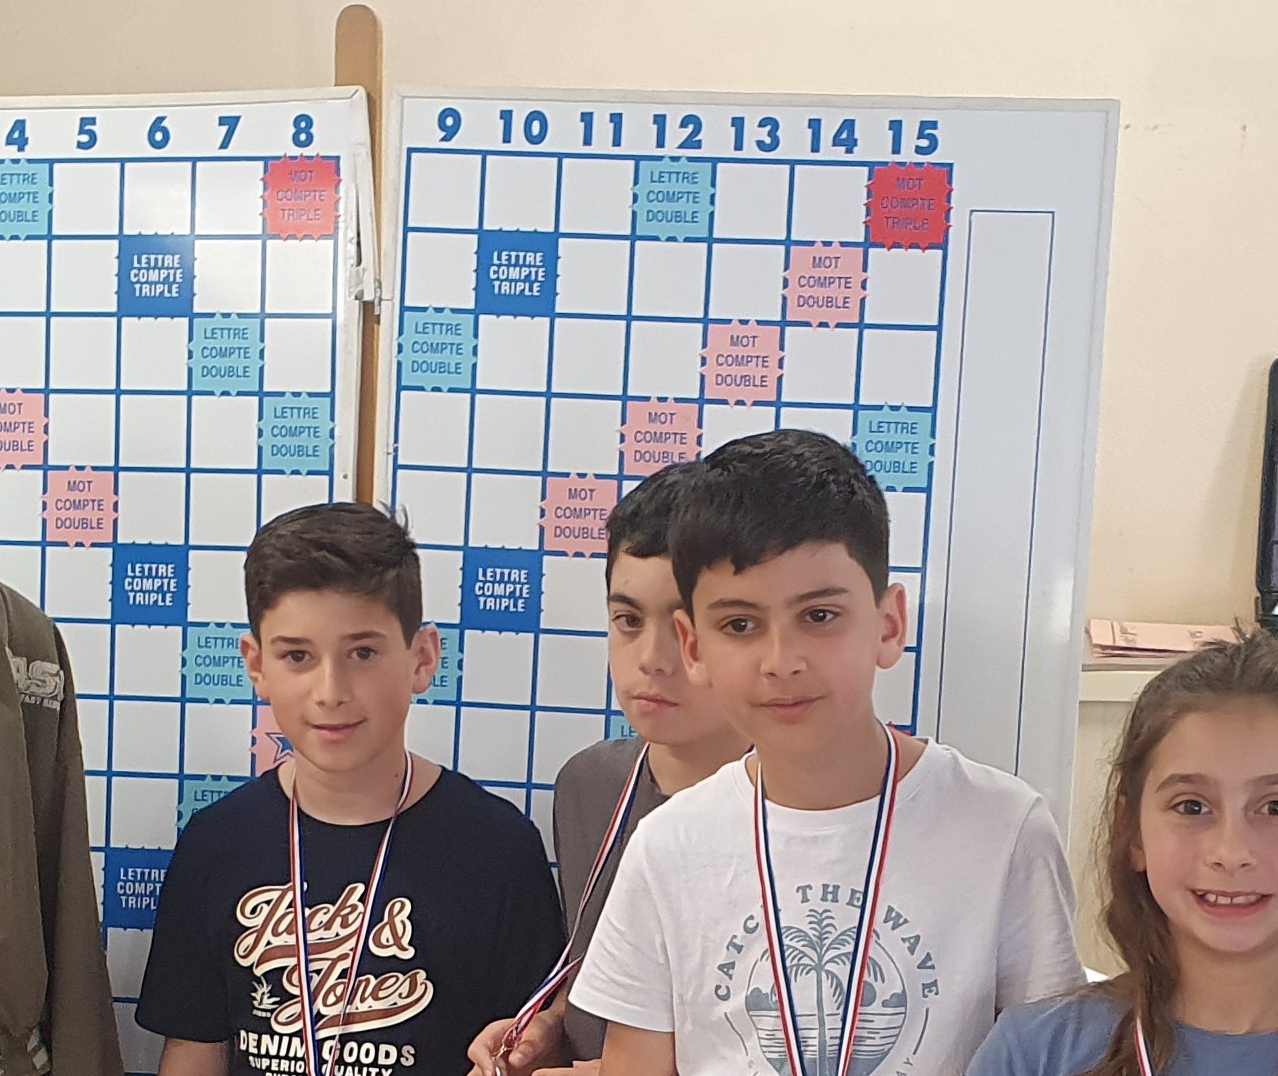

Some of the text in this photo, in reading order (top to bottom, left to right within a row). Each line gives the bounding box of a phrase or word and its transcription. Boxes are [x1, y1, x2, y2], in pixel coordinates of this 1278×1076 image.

[5, 119, 28, 153] 4
[76, 117, 98, 149] 5
[147, 117, 170, 150] 6
[218, 117, 242, 149] 7
[292, 114, 314, 146] 8
[438, 107, 938, 154] 9 10 11 12 13 14 15
[289, 170, 314, 183] MOT
[649, 171, 698, 185] LETTRE
[896, 177, 924, 190] MOT
[276, 189, 325, 202] COMPTE
[647, 190, 700, 204] COMPTE
[881, 196, 936, 211] COMPTE
[280, 208, 321, 222] TRIPLE
[646, 209, 699, 224] DOUBLE
[884, 216, 929, 231] TRIPLE
[133, 254, 181, 268] LETTRE
[493, 251, 544, 266] LETTRE
[812, 256, 841, 270] MOT
[130, 268, 183, 282] COMPTE
[490, 265, 545, 281] COMPTE
[133, 282, 180, 297] TRIPLE
[493, 280, 541, 296] TRIPLE
[798, 274, 852, 290] COMPTE
[797, 294, 850, 309] DOUBLE
[203, 326, 249, 340] LETTRE
[414, 321, 461, 336] LETTRE
[411, 341, 463, 356] COMPTE
[729, 334, 758, 349] MOT
[201, 345, 250, 360] COMPTE
[411, 360, 462, 375] DOUBLE
[716, 354, 769, 369] COMPTE
[201, 364, 250, 379] DOUBLE
[715, 373, 768, 388] DOUBLE
[272, 405, 319, 420] LETTRE
[647, 411, 676, 426] MOT
[270, 424, 321, 439] COMPTE
[869, 421, 918, 435] LETTRE
[634, 430, 687, 446] COMPTE
[270, 443, 320, 458] DOUBLE
[865, 440, 919, 455] COMPTE
[633, 449, 685, 465] DOUBLE
[865, 460, 917, 475] DOUBLE
[67, 480, 92, 493] MOT
[568, 488, 596, 502] MOT
[55, 499, 104, 512] COMPTE
[554, 507, 607, 522] COMPTE
[55, 517, 103, 530] DOUBLE
[553, 526, 606, 541] DOUBLE
[127, 563, 175, 577] LETTRE
[478, 568, 528, 583] LETTRE
[124, 577, 176, 592] COMPTE
[475, 582, 530, 597] COMPTE
[128, 592, 173, 605] TRIPLE
[479, 597, 525, 612] TRIPLE
[194, 655, 244, 668] COMPTE
[194, 672, 243, 687] DOUBLE
[117, 881, 162, 896] COMPT
[120, 896, 156, 910] TRIPL
[234, 882, 415, 976] Jack &
[714, 883, 940, 1002] CATC THE WAVE
[271, 950, 434, 1040] Jones
[322, 1040, 415, 1067] GOODS
[248, 1056, 308, 1073] SUPERIO
